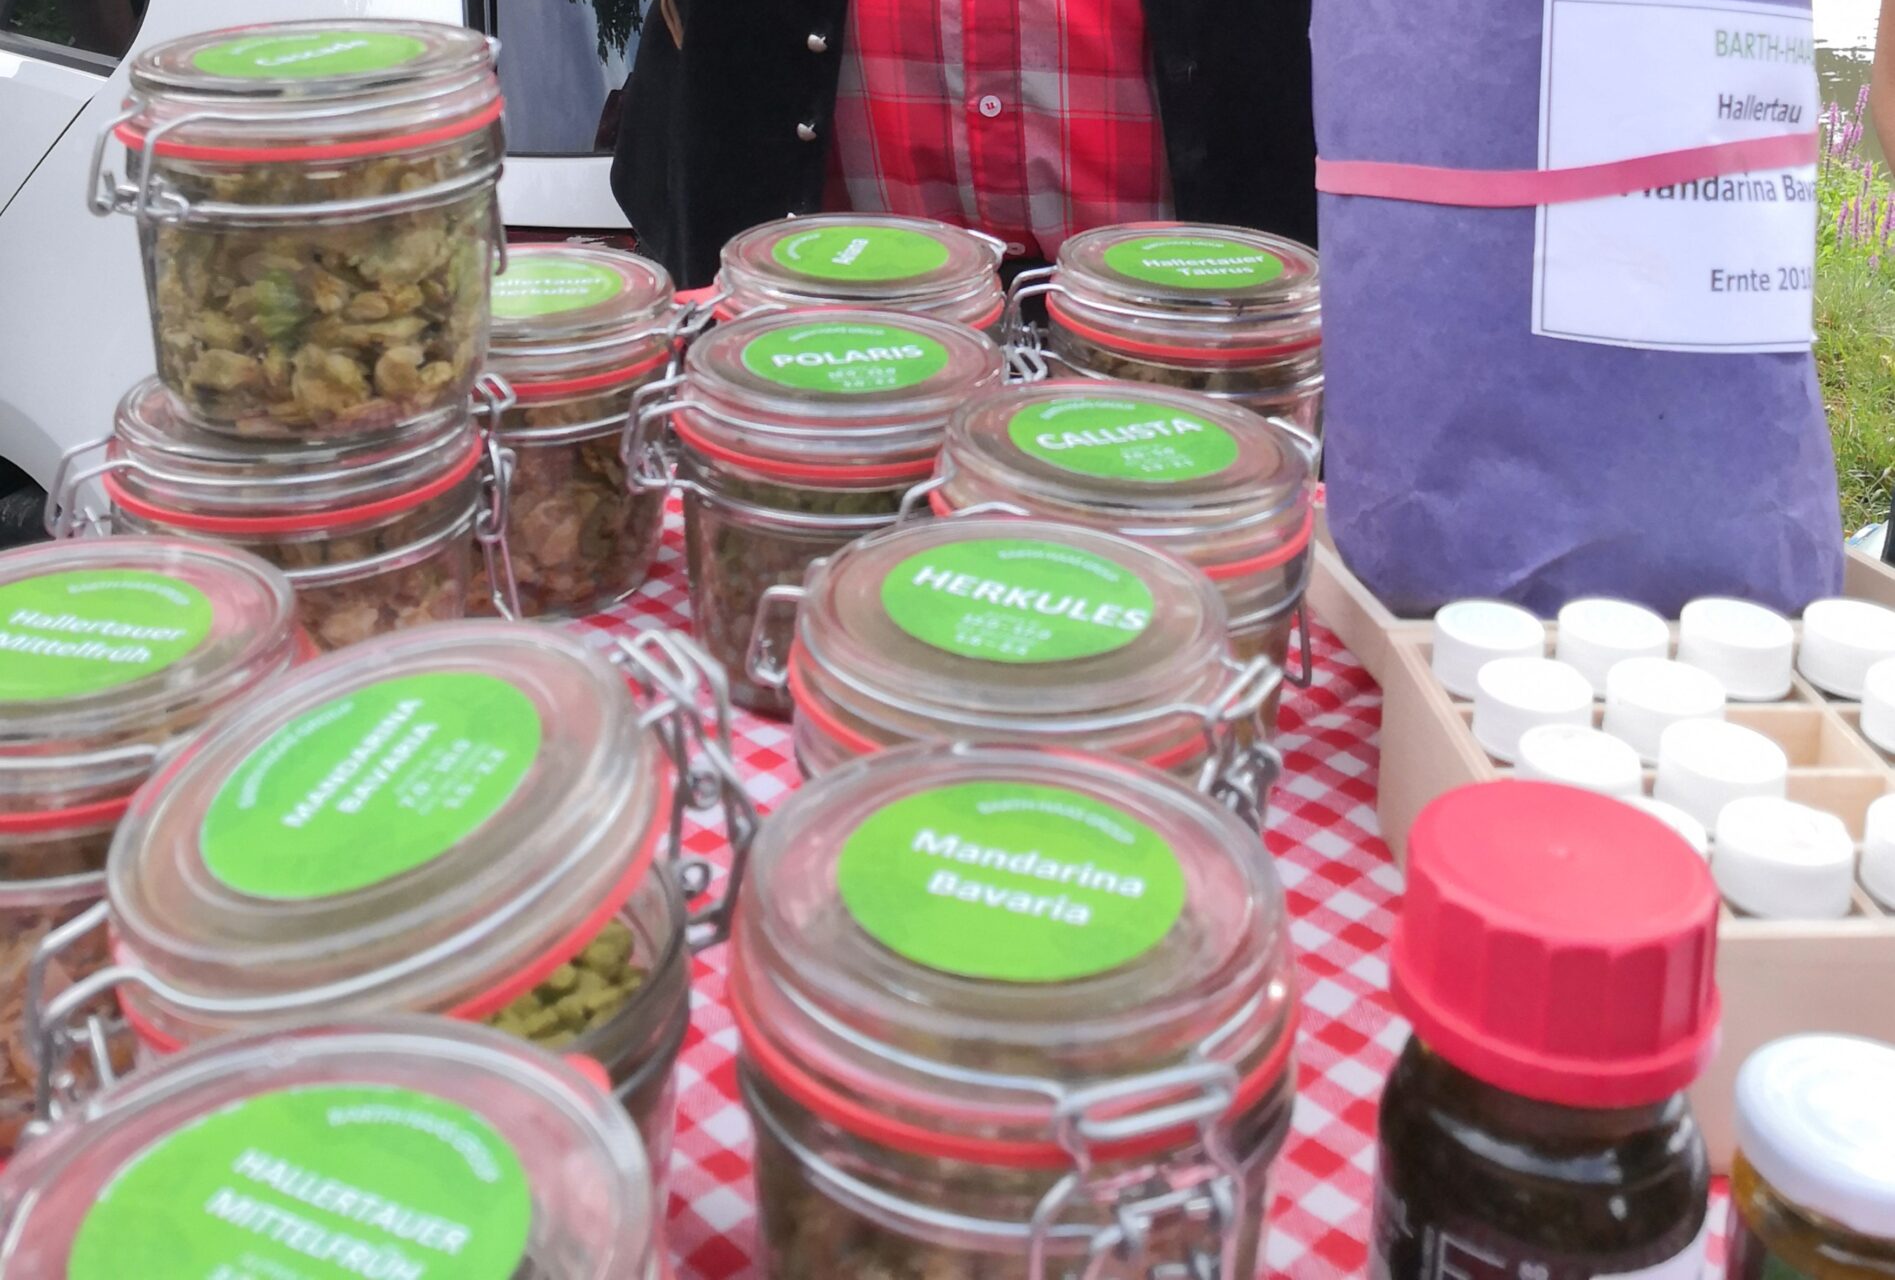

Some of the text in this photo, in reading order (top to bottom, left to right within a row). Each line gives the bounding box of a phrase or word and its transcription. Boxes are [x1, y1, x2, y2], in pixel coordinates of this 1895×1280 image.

[1717, 93, 1803, 125] Hallertau
[1620, 171, 1777, 202] andarina
[1141, 254, 1265, 268] Hallertauer
[1176, 266, 1254, 277] Taurus
[1710, 269, 1771, 292] Ernte
[771, 344, 925, 368] POLARIS
[1036, 417, 1204, 450] CALLISTA
[911, 565, 1150, 631] HERKULES
[8, 608, 188, 641] Hallertauer
[280, 698, 425, 828] MANDARINA
[336, 721, 438, 814] BAVARIA
[910, 827, 1147, 898] Mandarina
[926, 869, 1093, 927] Bavaria
[232, 1147, 471, 1255] HALLERTAUER
